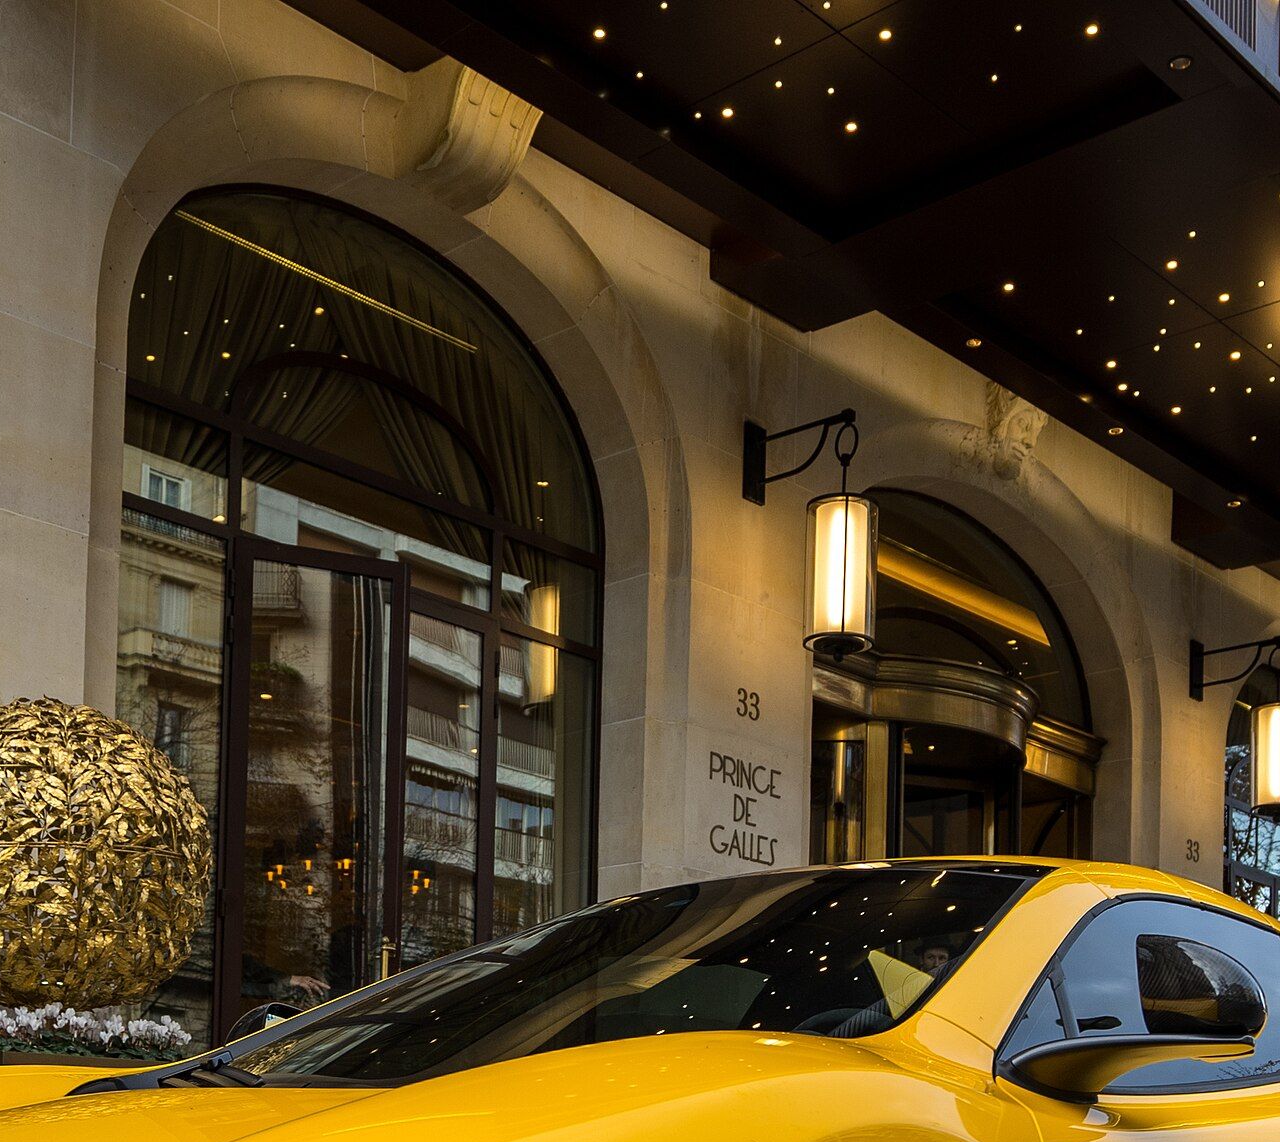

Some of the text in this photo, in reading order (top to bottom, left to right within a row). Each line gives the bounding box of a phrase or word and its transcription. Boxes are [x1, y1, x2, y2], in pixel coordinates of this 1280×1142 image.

[736, 687, 761, 722] 33
[709, 751, 782, 799] PRINCE
[733, 794, 758, 827] DE
[709, 825, 778, 866] GALLES
[1186, 839, 1200, 863] 33
